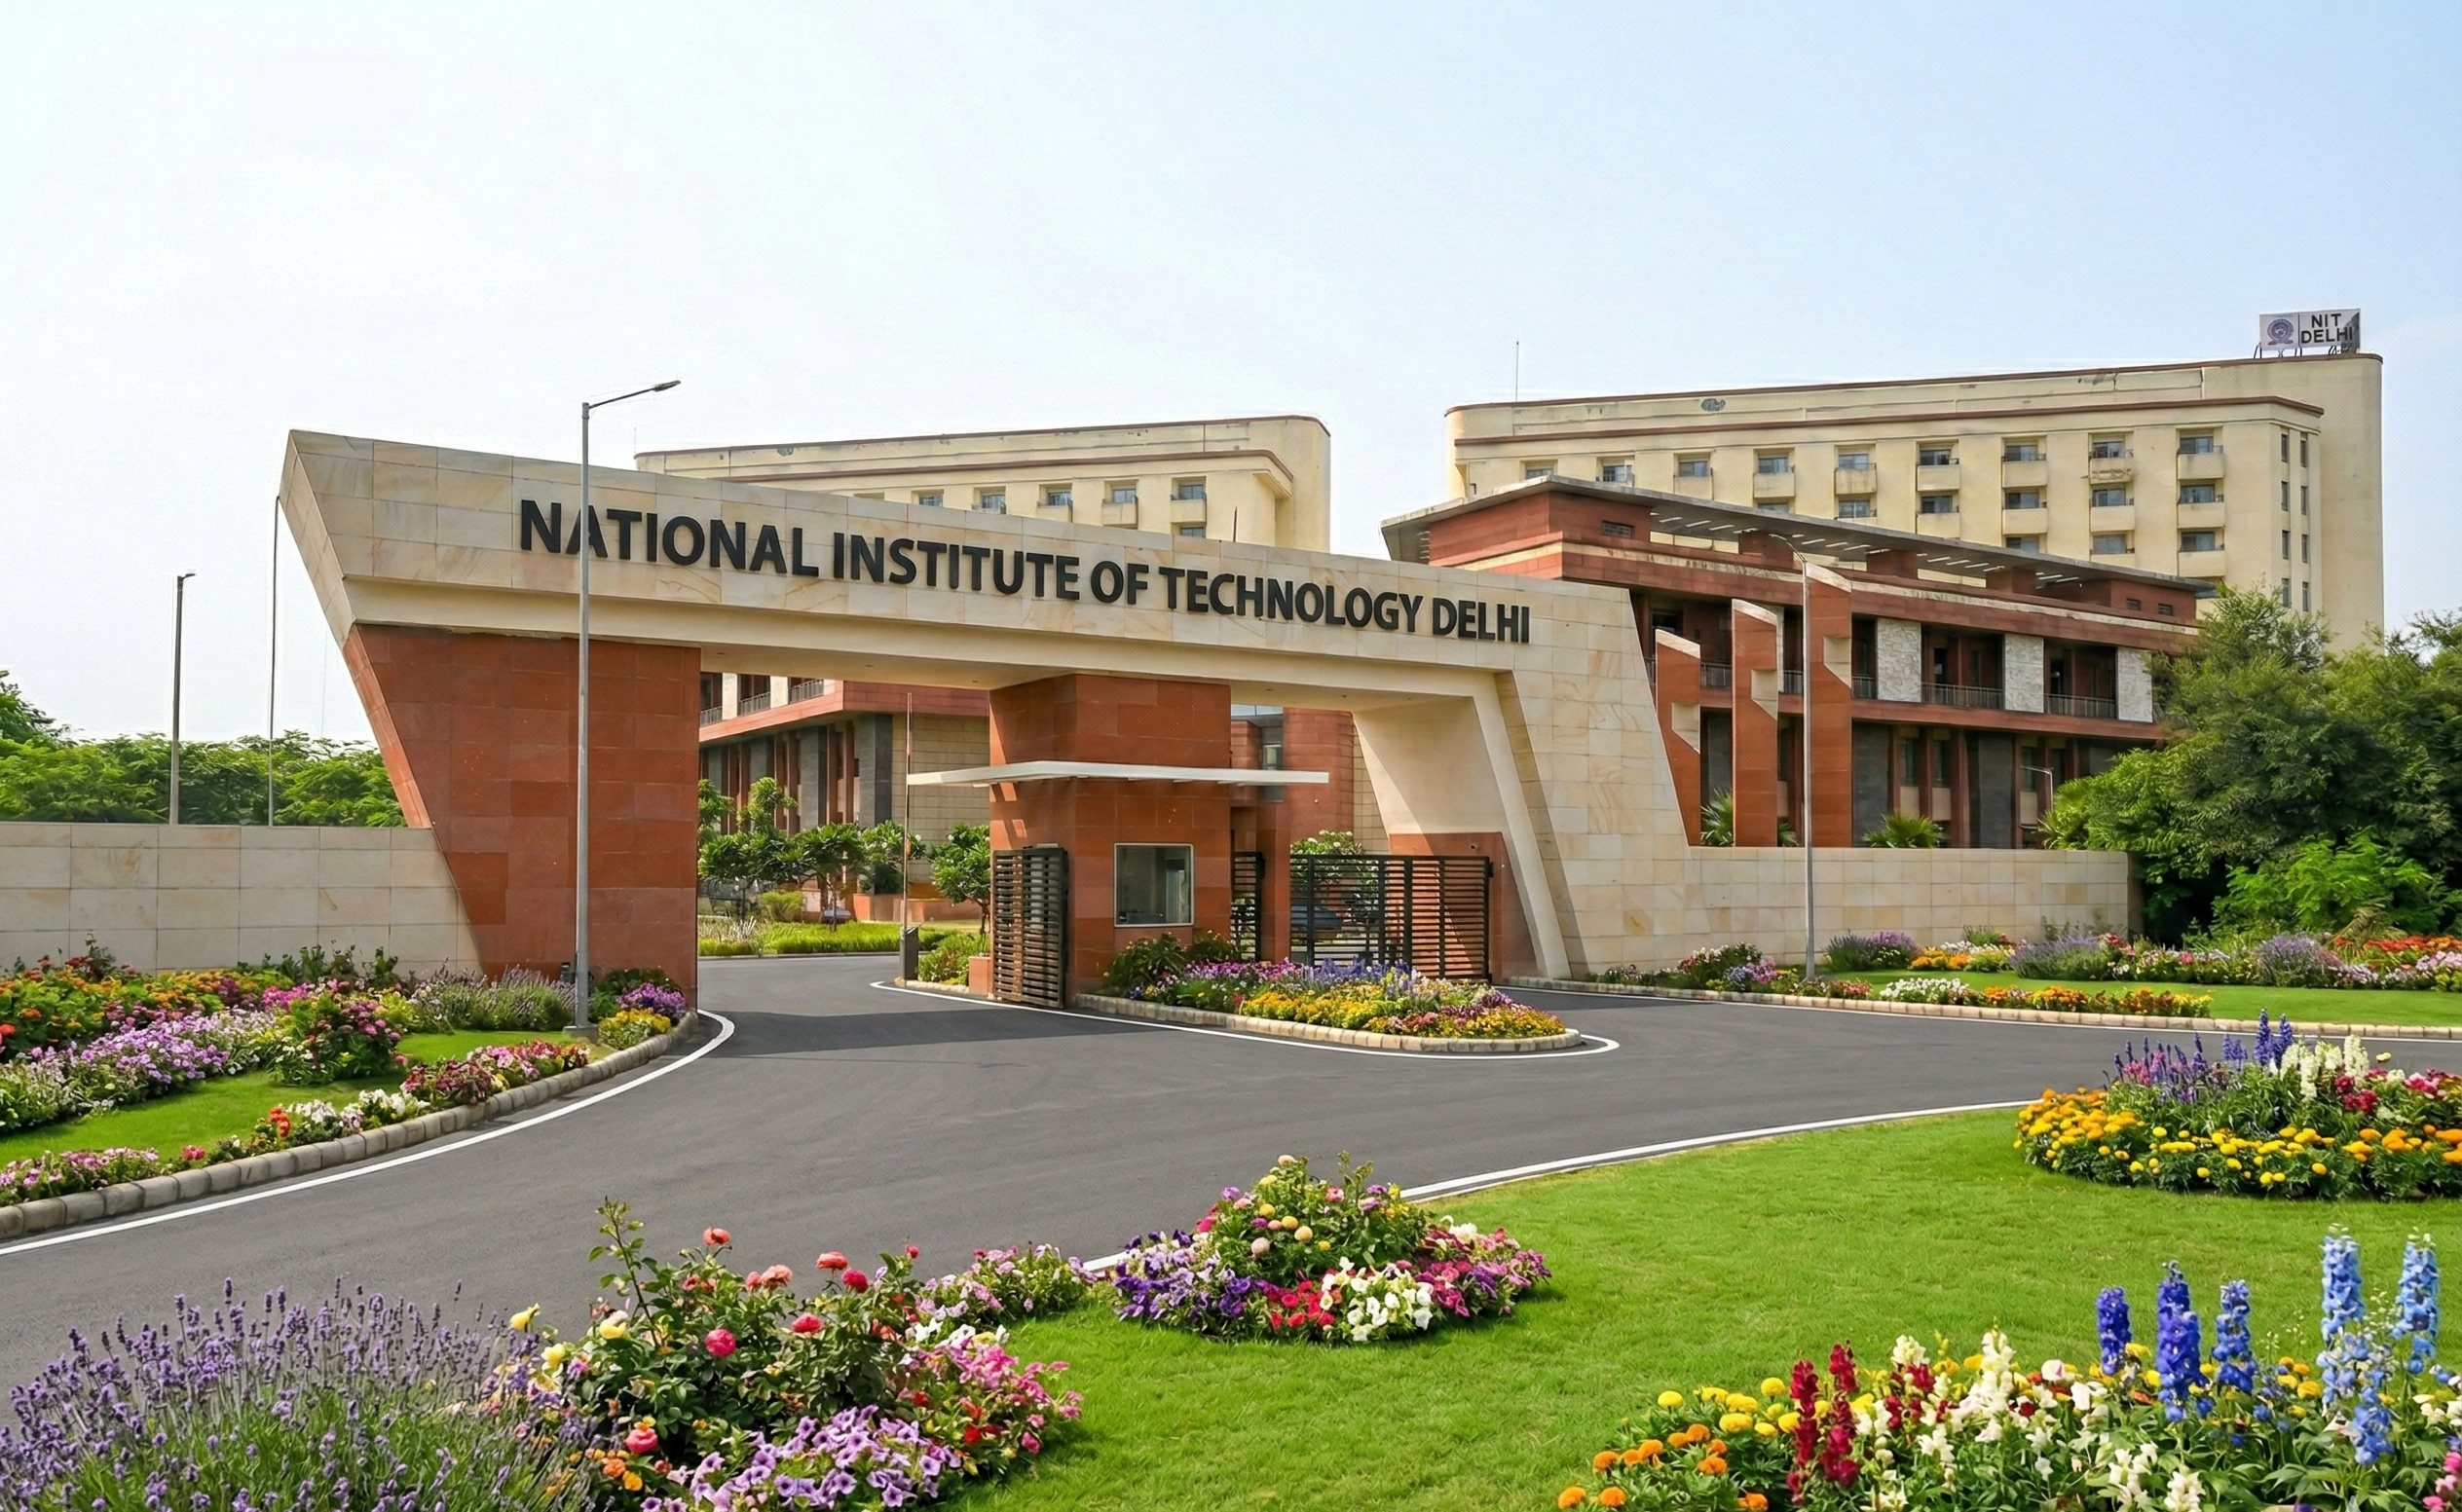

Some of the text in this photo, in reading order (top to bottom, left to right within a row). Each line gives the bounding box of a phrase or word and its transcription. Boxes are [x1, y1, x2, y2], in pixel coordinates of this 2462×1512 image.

[2311, 313, 2341, 328] NIT
[2301, 326, 2353, 344] DELHI
[520, 499, 1530, 644] NATIONAL INSTITUTE OF TECHNOLOGY DELHI
